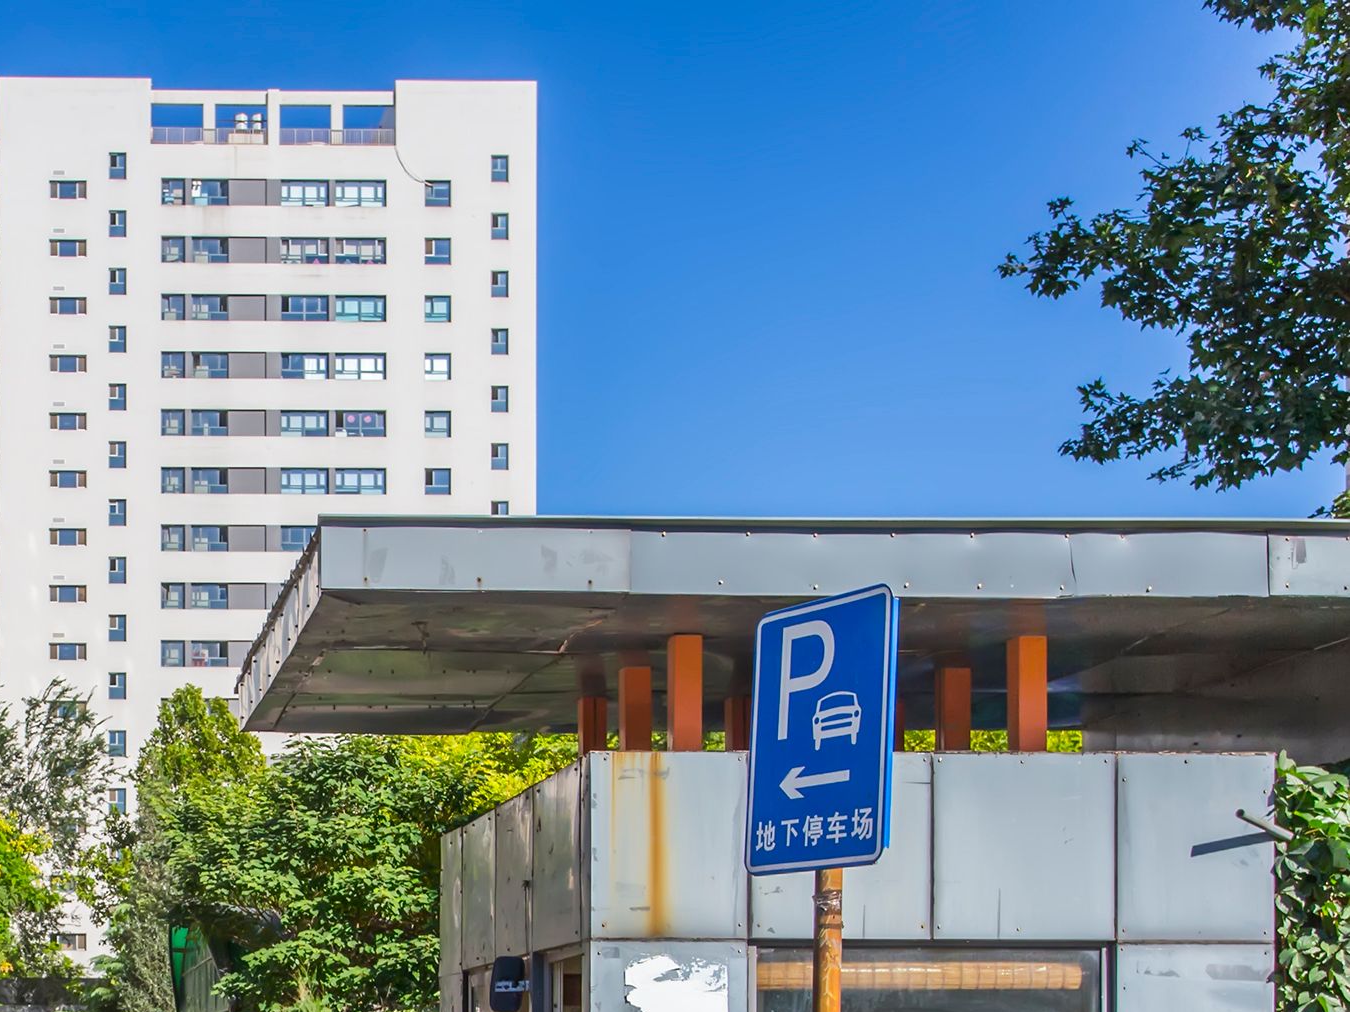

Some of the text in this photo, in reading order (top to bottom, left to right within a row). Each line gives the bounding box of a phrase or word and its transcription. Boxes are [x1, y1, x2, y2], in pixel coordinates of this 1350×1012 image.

[777, 619, 835, 741] P
[755, 806, 874, 852] 地下停车场
